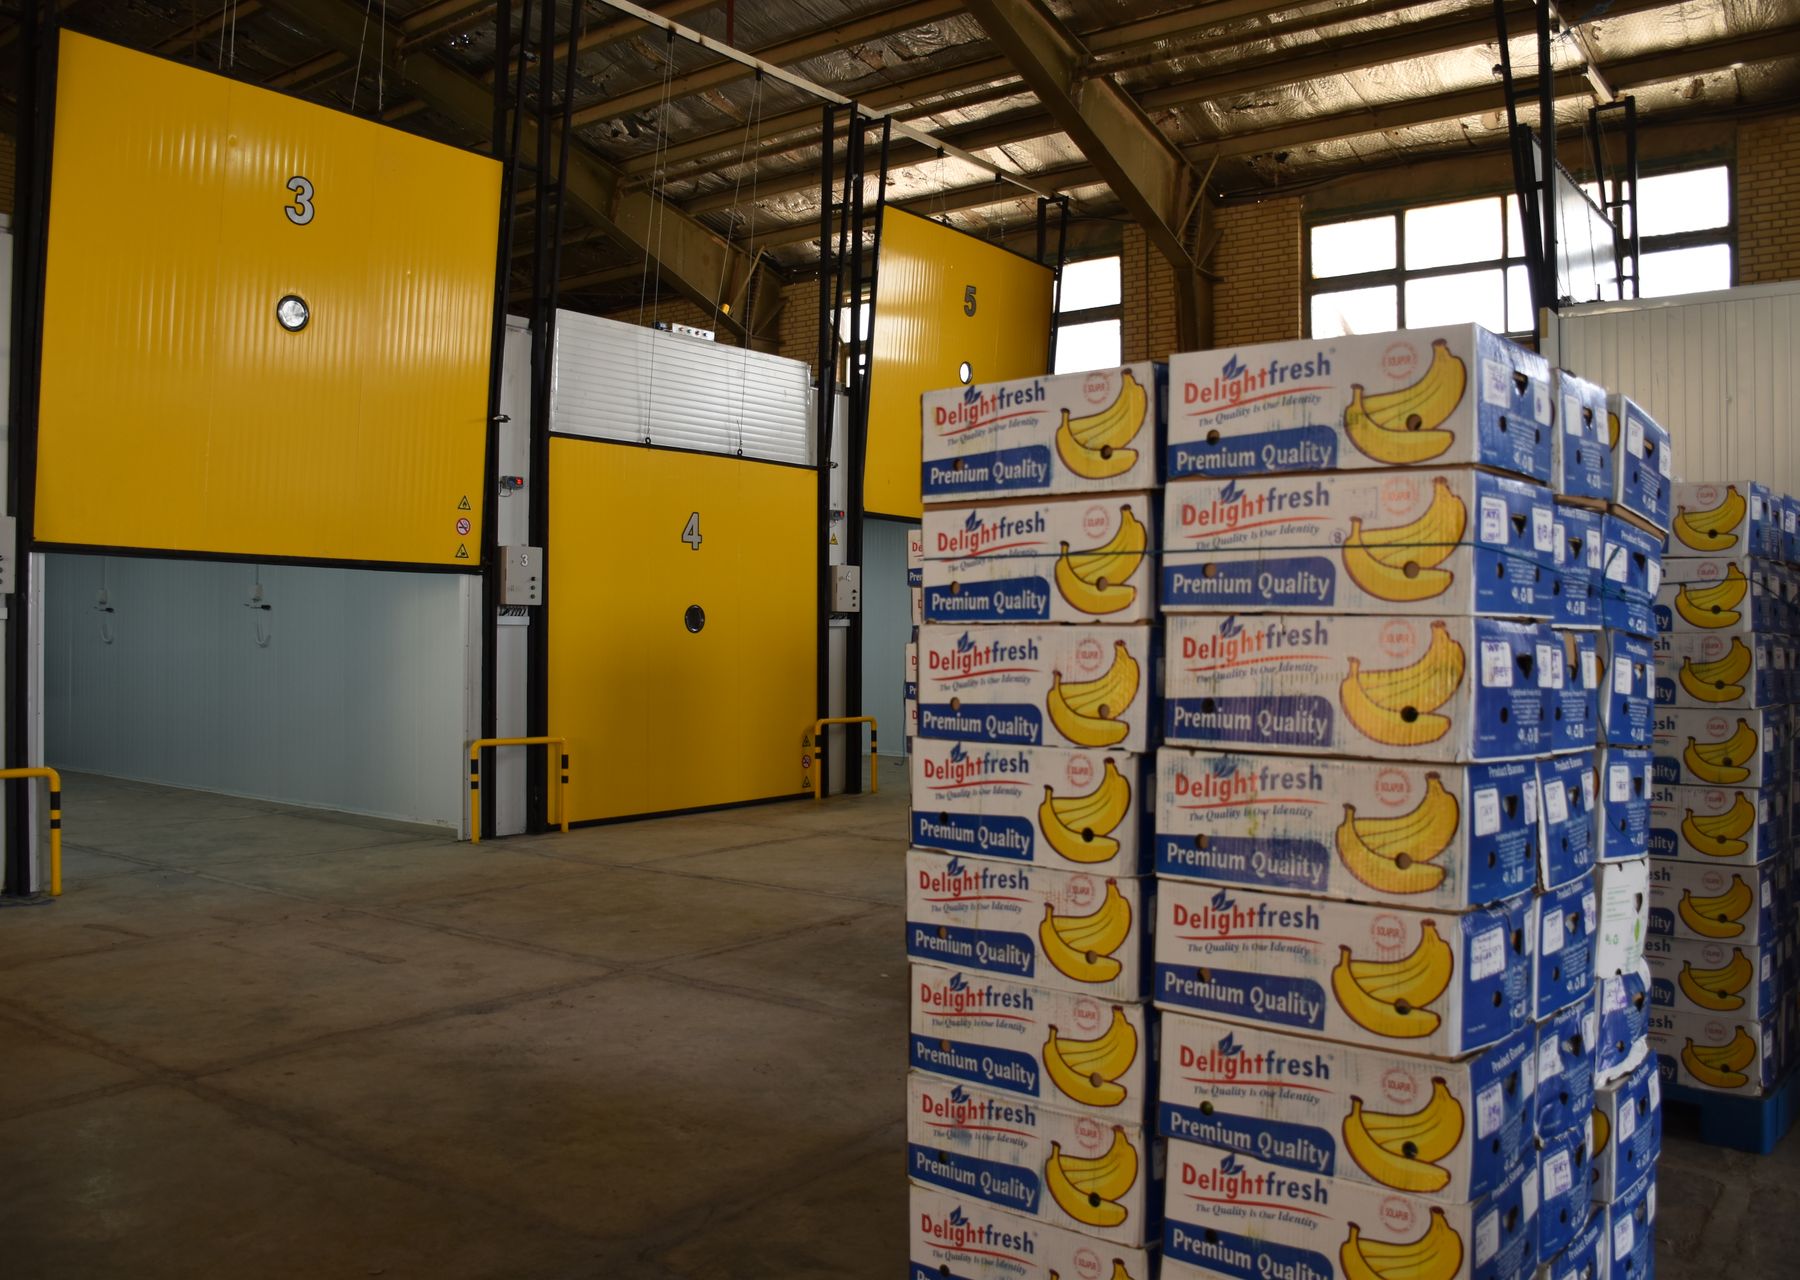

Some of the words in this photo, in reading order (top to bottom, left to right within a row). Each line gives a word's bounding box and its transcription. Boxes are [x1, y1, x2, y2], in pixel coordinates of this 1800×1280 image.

[285, 176, 315, 226] 3
[964, 285, 976, 318] 5
[1184, 351, 1331, 404] Delightfresh
[935, 380, 1045, 426] Delightfresh
[1199, 417, 1214, 427] The
[1216, 407, 1250, 425] Quality
[1282, 394, 1322, 408] Identity
[959, 428, 987, 445] Quality
[1008, 417, 1040, 429] Identity
[930, 464, 989, 485] Premium
[993, 460, 1047, 482] Quality
[1176, 448, 1256, 471] Premium
[1262, 444, 1332, 469] Quality
[1182, 482, 1329, 527] Delightfresh
[682, 512, 702, 550] 4
[937, 511, 1045, 553] Delightfresh
[1196, 540, 1211, 551] The
[1212, 532, 1248, 550] Quality
[1280, 523, 1320, 537] Identity
[520, 554, 528, 567] 3
[1173, 571, 1251, 594] Premium
[1258, 569, 1330, 598] Quality
[932, 592, 990, 612] Premium
[993, 591, 1046, 612] Quality
[928, 638, 1039, 672] Delightfresh
[1183, 620, 1328, 662] Delightfresh
[940, 683, 951, 692] The
[952, 678, 979, 692] Quality
[1001, 674, 1031, 685] Identity
[1279, 662, 1318, 675] Identity
[923, 711, 981, 732] Premium
[986, 715, 1039, 743] Quality
[1174, 706, 1250, 730] Premium
[1258, 709, 1327, 739] Quality
[924, 752, 1029, 783] Delightfresh
[1175, 764, 1322, 801] Delightfresh
[1652, 764, 1676, 781] ality
[935, 792, 946, 800] The
[946, 789, 971, 801] Quality
[992, 786, 1022, 799] Identity
[1190, 812, 1204, 822] The
[1206, 807, 1241, 822] Quality
[1272, 806, 1313, 819] Identity
[920, 818, 975, 842] Premium
[978, 825, 1030, 855] Quality
[1648, 836, 1674, 852] ality
[1167, 842, 1245, 870] Premium
[1252, 852, 1324, 884] Quality
[919, 869, 1029, 897] Delightfresh
[931, 904, 942, 912] The
[942, 902, 969, 914] Quality
[991, 901, 1022, 914] Identity
[1173, 903, 1320, 935] Delightfresh
[1649, 916, 1671, 932] lity
[915, 929, 973, 957] Premium
[975, 940, 1031, 972] Quality
[1188, 943, 1202, 952] The
[1204, 942, 1240, 954] Quality
[1270, 942, 1310, 957] Identity
[921, 983, 1033, 1013] Delightfresh
[1164, 971, 1244, 1004] Premium
[1250, 986, 1320, 1024] Quality
[1652, 986, 1672, 1003] lity
[931, 1018, 944, 1026] The
[944, 1017, 972, 1029] Quality
[995, 1020, 1026, 1034] Identity
[916, 1041, 978, 1072] Premium
[982, 1055, 1036, 1091] Quality
[1180, 1044, 1330, 1080] Delightfresh
[922, 1093, 1036, 1126] Delightfresh
[1194, 1086, 1208, 1095] The
[1210, 1085, 1246, 1098] Quality
[1278, 1088, 1320, 1105] Identity
[933, 1130, 945, 1138] The
[997, 1134, 1028, 1149] Identity
[1170, 1112, 1251, 1149] Premium
[1257, 1132, 1330, 1172] Quality
[916, 1151, 976, 1187] Premium
[980, 1171, 1036, 1208] Quality
[1182, 1162, 1328, 1204] Delightfresh
[1196, 1204, 1210, 1214] The
[1213, 1205, 1247, 1218] Quality
[1278, 1210, 1318, 1230] Identity
[921, 1213, 1034, 1255] Delightfresh
[932, 1250, 944, 1259] The
[944, 1251, 972, 1264] Quality
[996, 1259, 1027, 1277] Identity
[1173, 1229, 1251, 1269] Premium
[1257, 1253, 1328, 1280] Qualit
